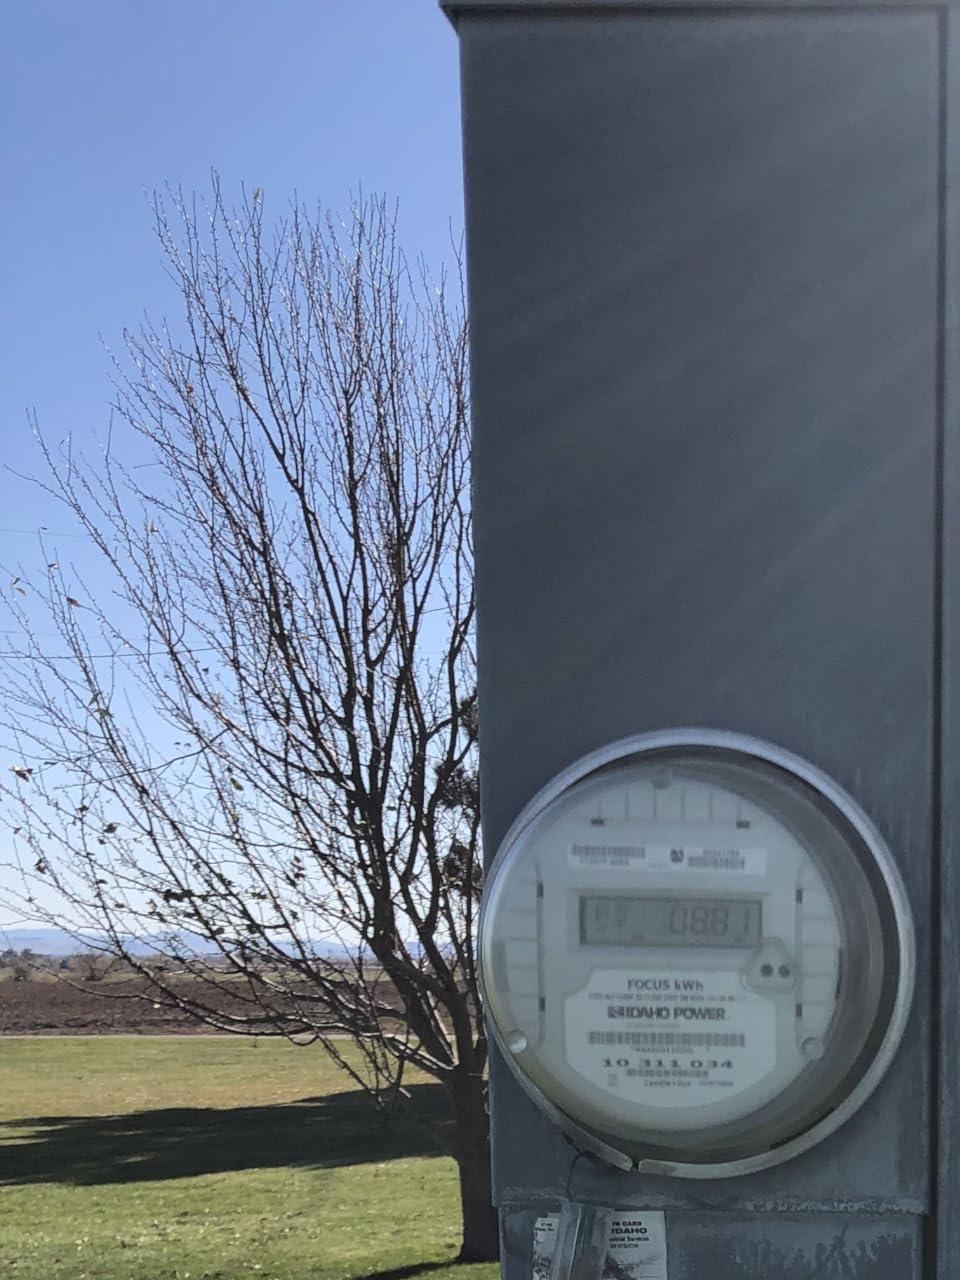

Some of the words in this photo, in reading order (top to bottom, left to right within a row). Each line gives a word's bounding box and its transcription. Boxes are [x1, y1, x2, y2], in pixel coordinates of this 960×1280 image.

[627, 978, 671, 992] FOCUS
[673, 978, 704, 993] kWh
[628, 1006, 671, 1020] IDAHO
[673, 1006, 727, 1021] POWER
[611, 1227, 648, 1235] IDAHO
